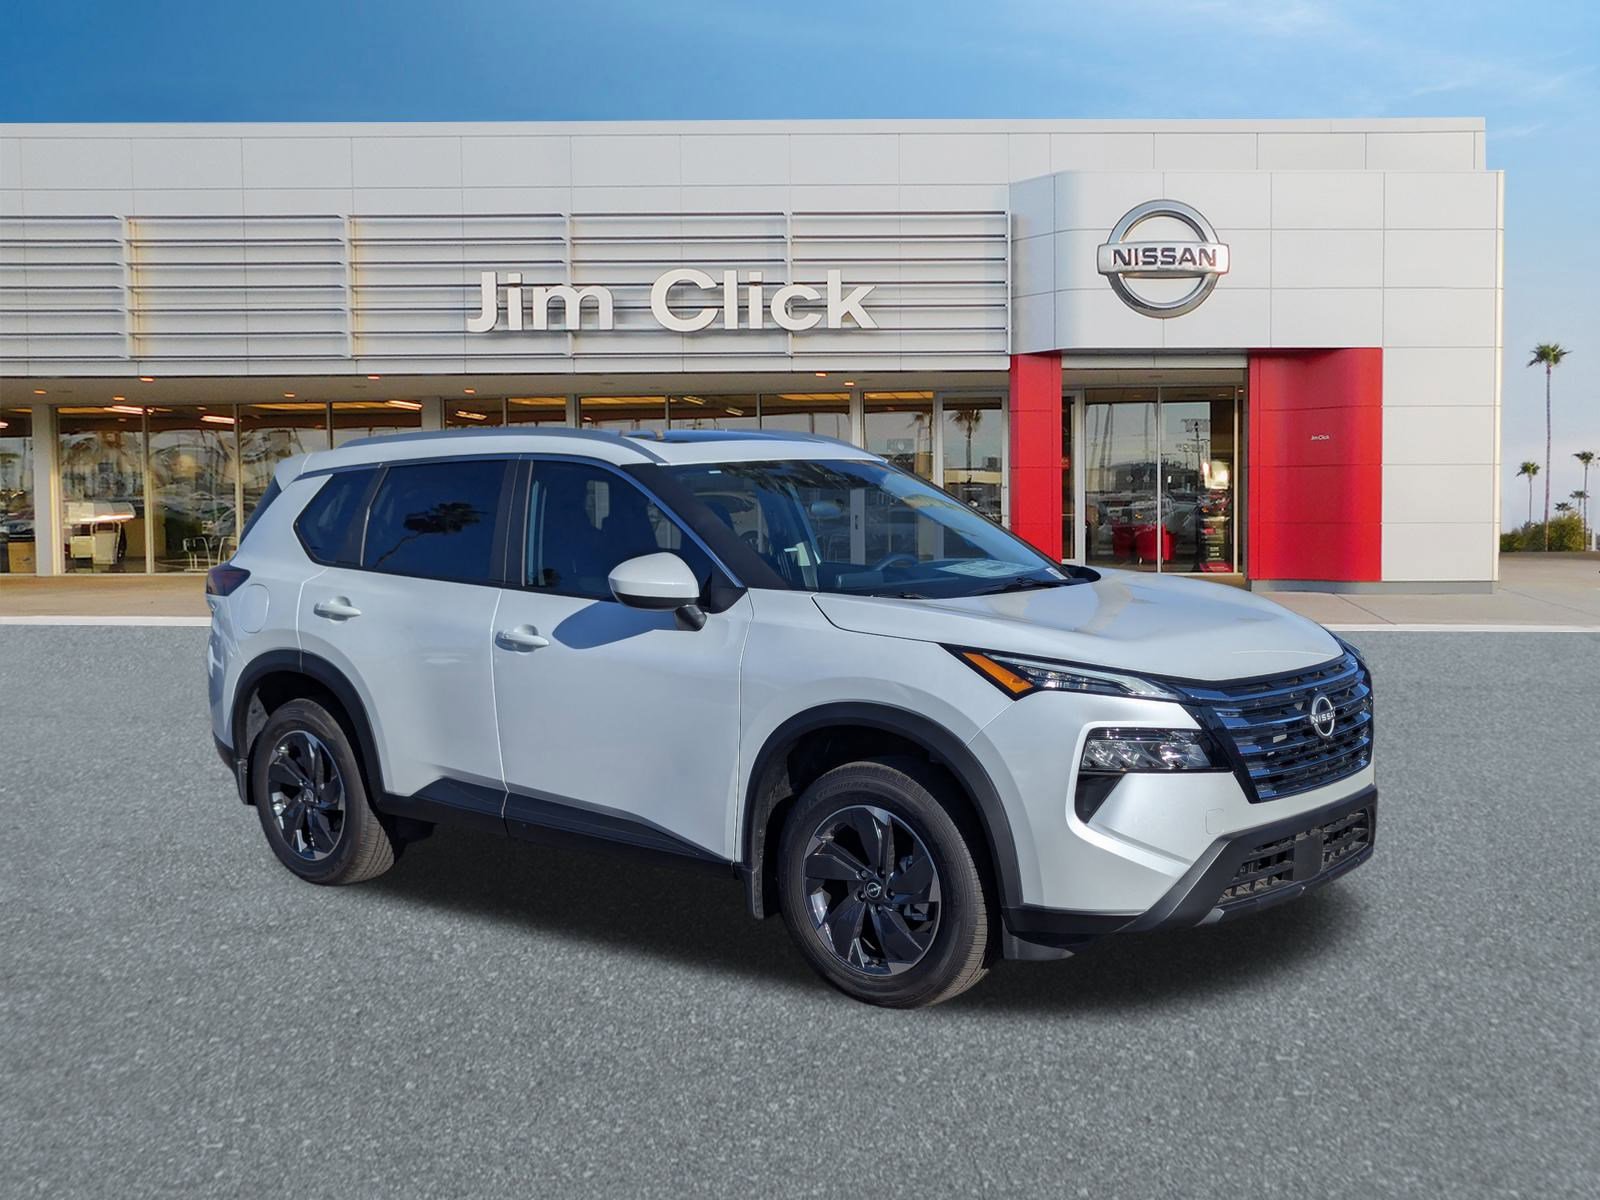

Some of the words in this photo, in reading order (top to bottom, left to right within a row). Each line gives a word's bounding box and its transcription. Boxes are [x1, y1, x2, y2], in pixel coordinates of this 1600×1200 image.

[1112, 247, 1217, 267] NISSAN
[466, 270, 614, 334] Jim
[650, 268, 879, 333] Click
